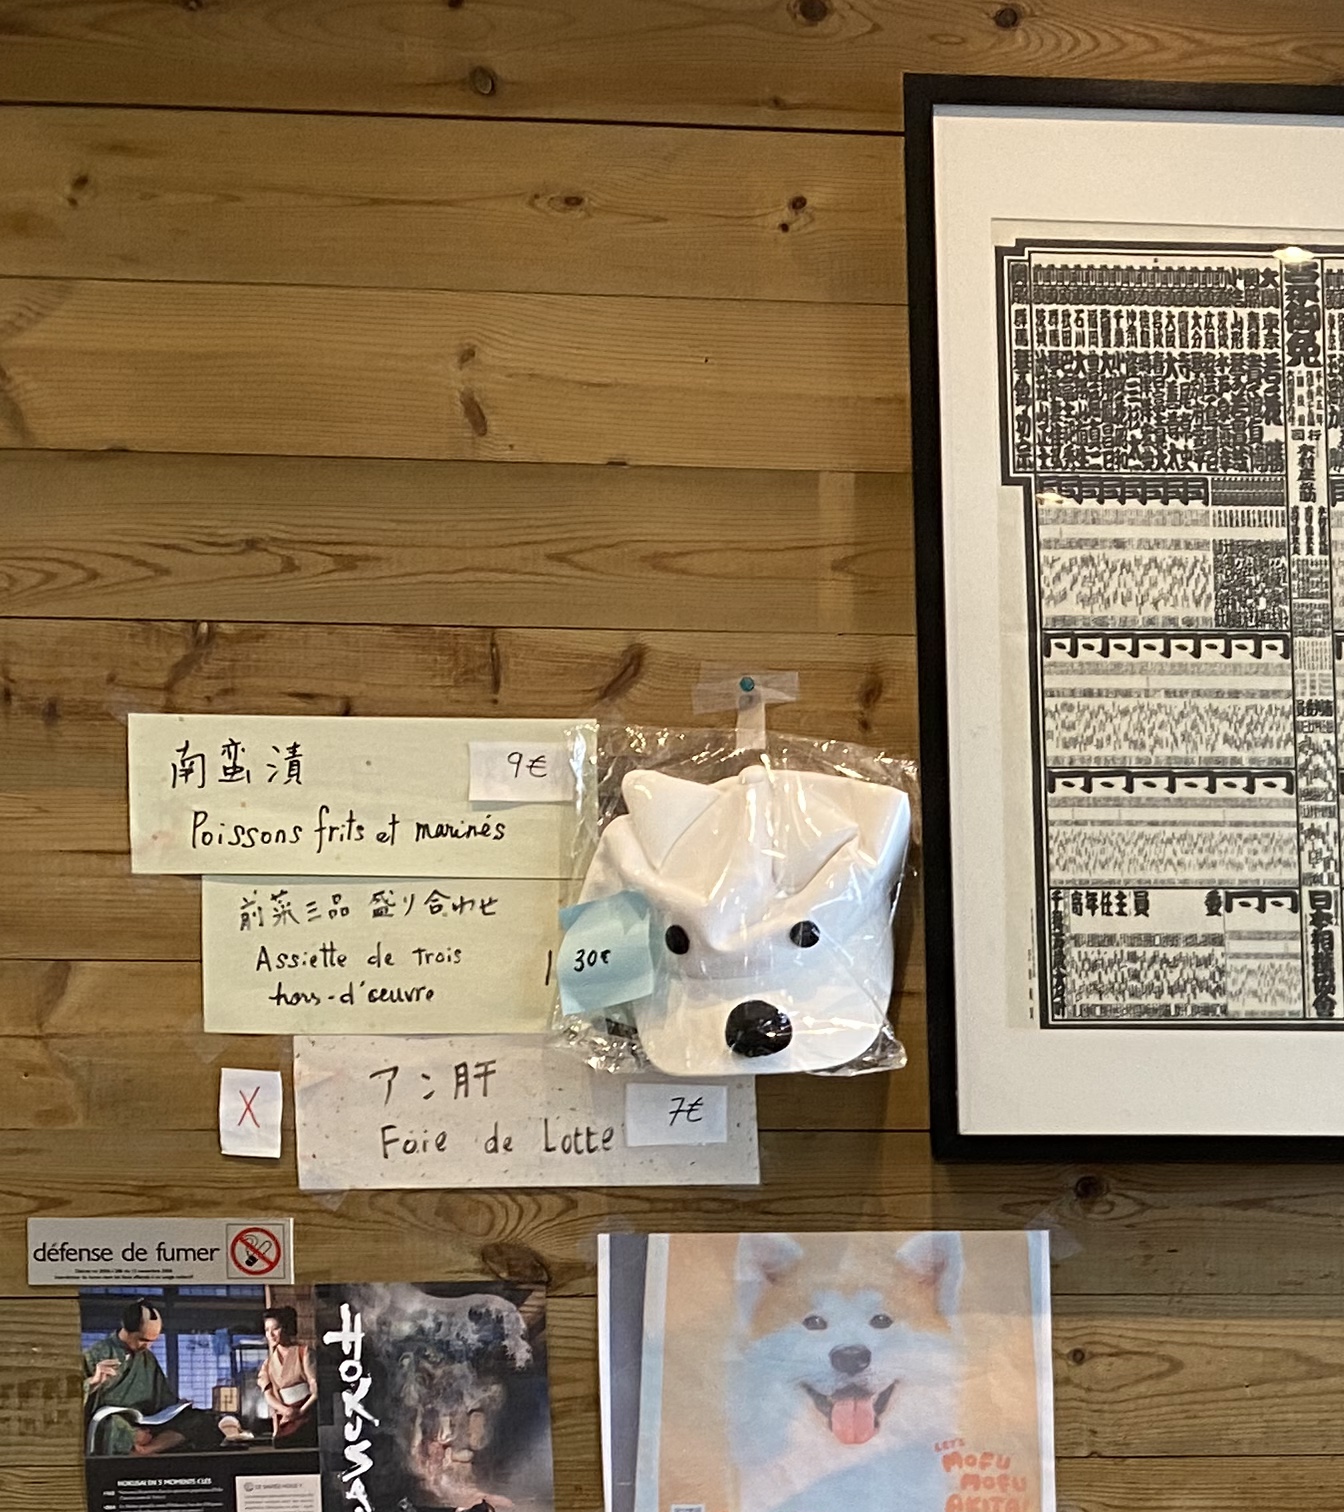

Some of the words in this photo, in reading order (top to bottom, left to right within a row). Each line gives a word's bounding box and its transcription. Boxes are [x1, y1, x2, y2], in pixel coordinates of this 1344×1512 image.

[508, 752, 547, 778] 9€
[192, 810, 302, 849] Poissons
[314, 805, 364, 854] frits
[376, 813, 400, 846] et
[256, 941, 347, 972] Assiette
[367, 941, 395, 968] de
[669, 1097, 704, 1126] 7€
[381, 1125, 447, 1159] Foie
[485, 1122, 513, 1154] de
[544, 1118, 614, 1154] Lotte
[33, 1242, 113, 1262] défense
[121, 1242, 148, 1262] de
[156, 1242, 220, 1262] fumer
